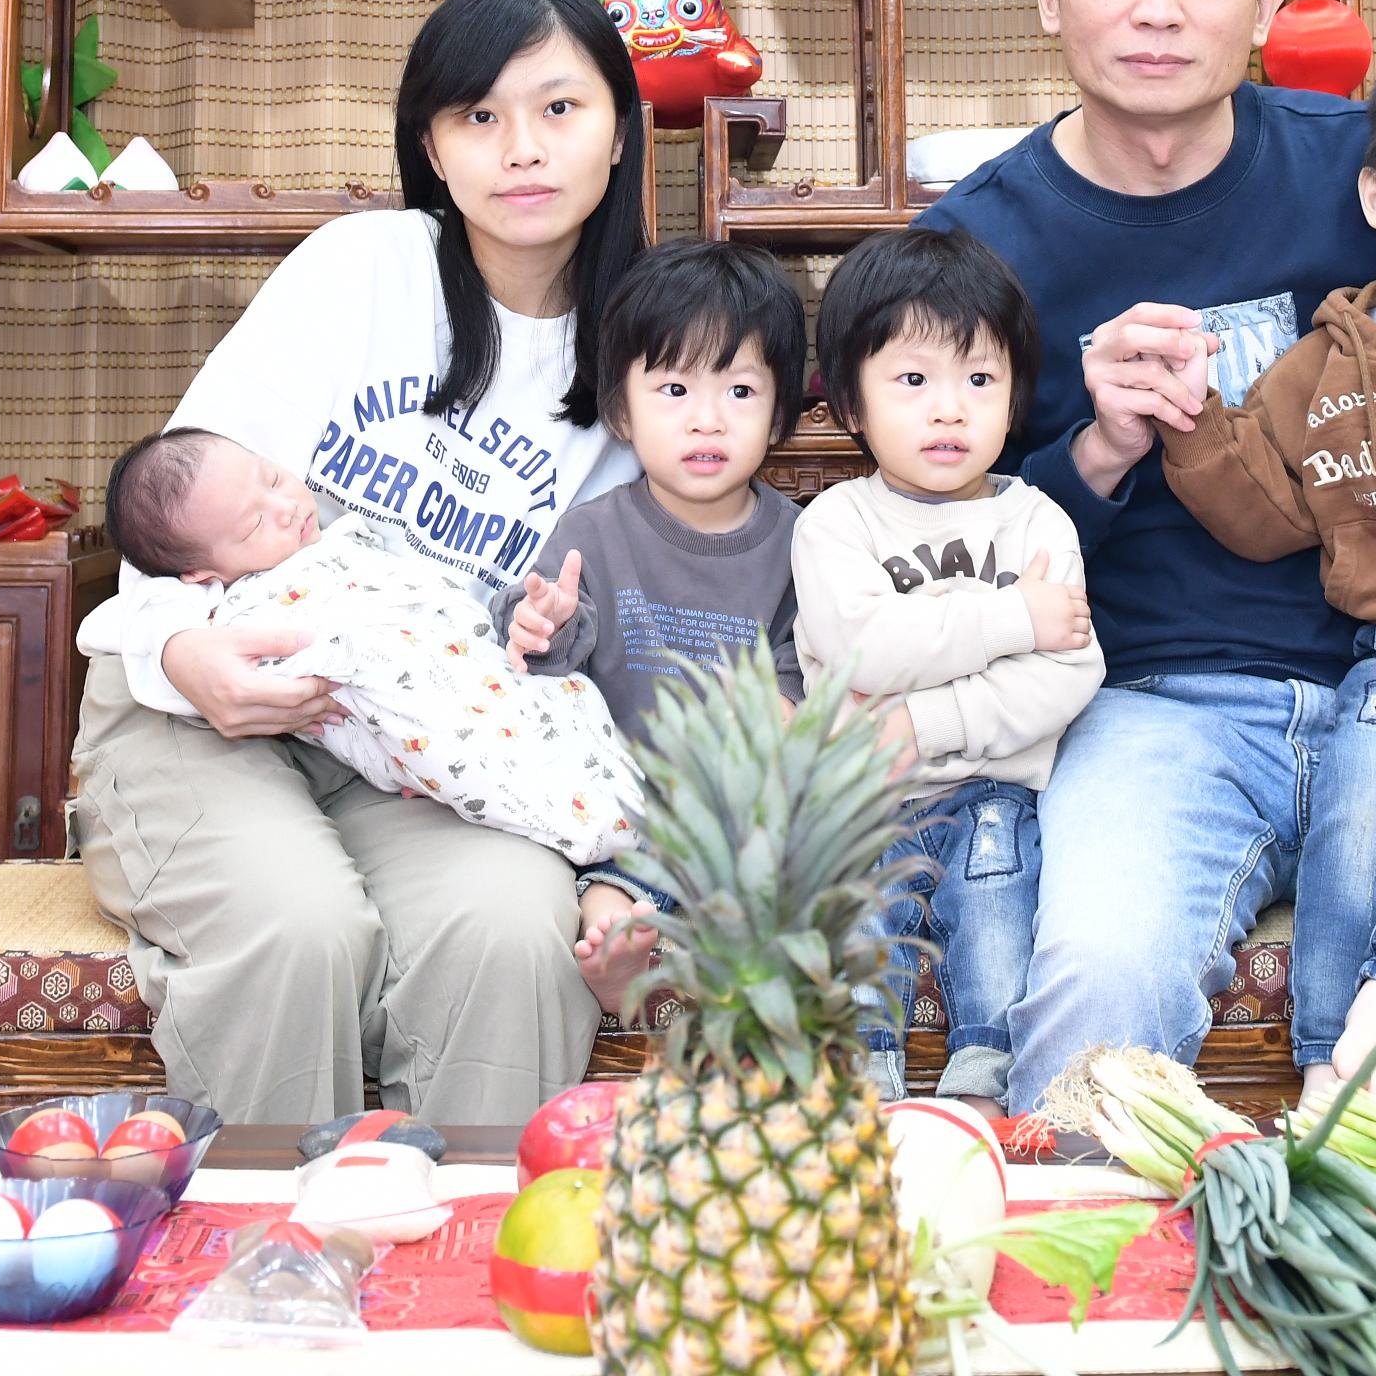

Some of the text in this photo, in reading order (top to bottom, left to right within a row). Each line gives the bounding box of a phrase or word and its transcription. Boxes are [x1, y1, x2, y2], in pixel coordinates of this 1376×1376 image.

[312, 420, 419, 514] PAPER
[425, 432, 491, 495] EST. 2009
[479, 417, 557, 512] SCOTT
[616, 588, 632, 598] HAS
[675, 608, 704, 619] HUMAN
[704, 611, 728, 622] GOOD
[729, 615, 746, 626] AND
[617, 607, 630, 616] WE
[631, 606, 648, 614] ARE
[671, 625, 686, 635] THE
[688, 629, 710, 638] GRAY
[710, 632, 734, 642] GOOD
[735, 636, 752, 646] AND
[625, 597, 637, 605] NO
[654, 613, 679, 624] ANGEL
[681, 618, 697, 627] FOR
[699, 620, 717, 630] GIVE
[718, 623, 734, 633] THE
[735, 626, 756, 637] DEVIL
[678, 636, 693, 645] THE
[694, 639, 715, 649] BACK
